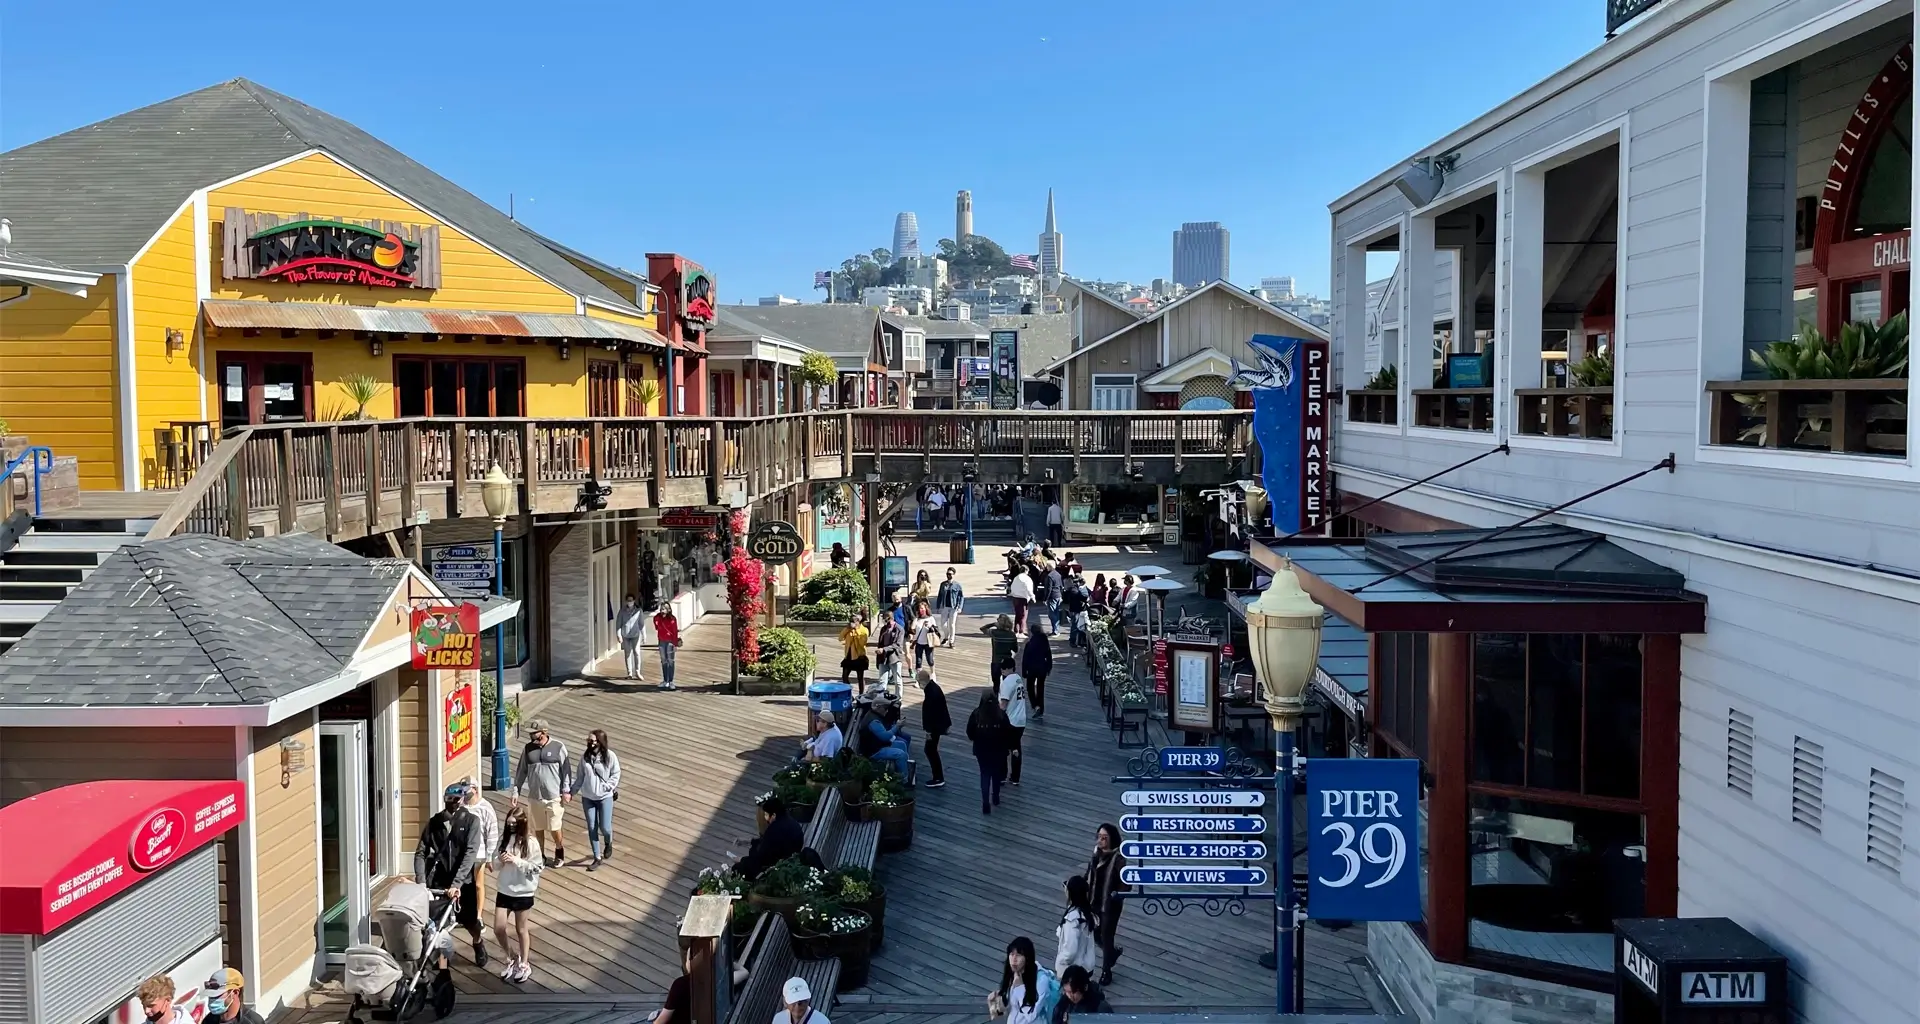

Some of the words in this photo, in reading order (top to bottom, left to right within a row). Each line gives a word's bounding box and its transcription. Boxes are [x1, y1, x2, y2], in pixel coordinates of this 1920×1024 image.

[1820, 92, 1879, 210] PUZZLES
[282, 270, 307, 283] The
[306, 265, 342, 283] Flavor
[343, 269, 356, 282] of
[359, 270, 396, 287] Mexico
[1308, 350, 1322, 416] PIER
[1306, 426, 1321, 527] MARKET
[754, 541, 797, 554] GOLD
[769, 534, 795, 543] Francisco
[444, 634, 476, 648] HOT
[426, 650, 474, 666] LICKS
[1316, 667, 1346, 705] SOURDOUGH
[458, 711, 471, 732] HOT
[453, 732, 470, 753] LICKS
[1168, 754, 1202, 766] PIER
[1204, 753, 1219, 766] 39
[1148, 793, 1188, 804] SWISS
[1193, 794, 1232, 804] LOUIS
[1320, 790, 1402, 817] PIER
[195, 820, 204, 833] ICED
[206, 812, 220, 827] COFFEE
[196, 805, 211, 821] COFFEE
[1153, 819, 1235, 830] RESTROOMS
[147, 821, 174, 855] Biscoff
[1146, 845, 1186, 856] LEVEL
[1190, 846, 1198, 856] 2
[1201, 846, 1246, 857] SHOPS
[1318, 822, 1406, 888] 39
[58, 880, 72, 895] FREE
[73, 867, 95, 887] BISCOFF
[96, 857, 115, 875] COOKIE
[1154, 871, 1180, 882] BAY
[1183, 872, 1226, 882] VIEWS
[50, 893, 72, 913] SERVED
[72, 885, 87, 900] WITH
[88, 876, 104, 893] EVERY
[104, 865, 123, 883] COFFEE
[1628, 946, 1657, 989] ATM
[1688, 974, 1755, 998] ATM
